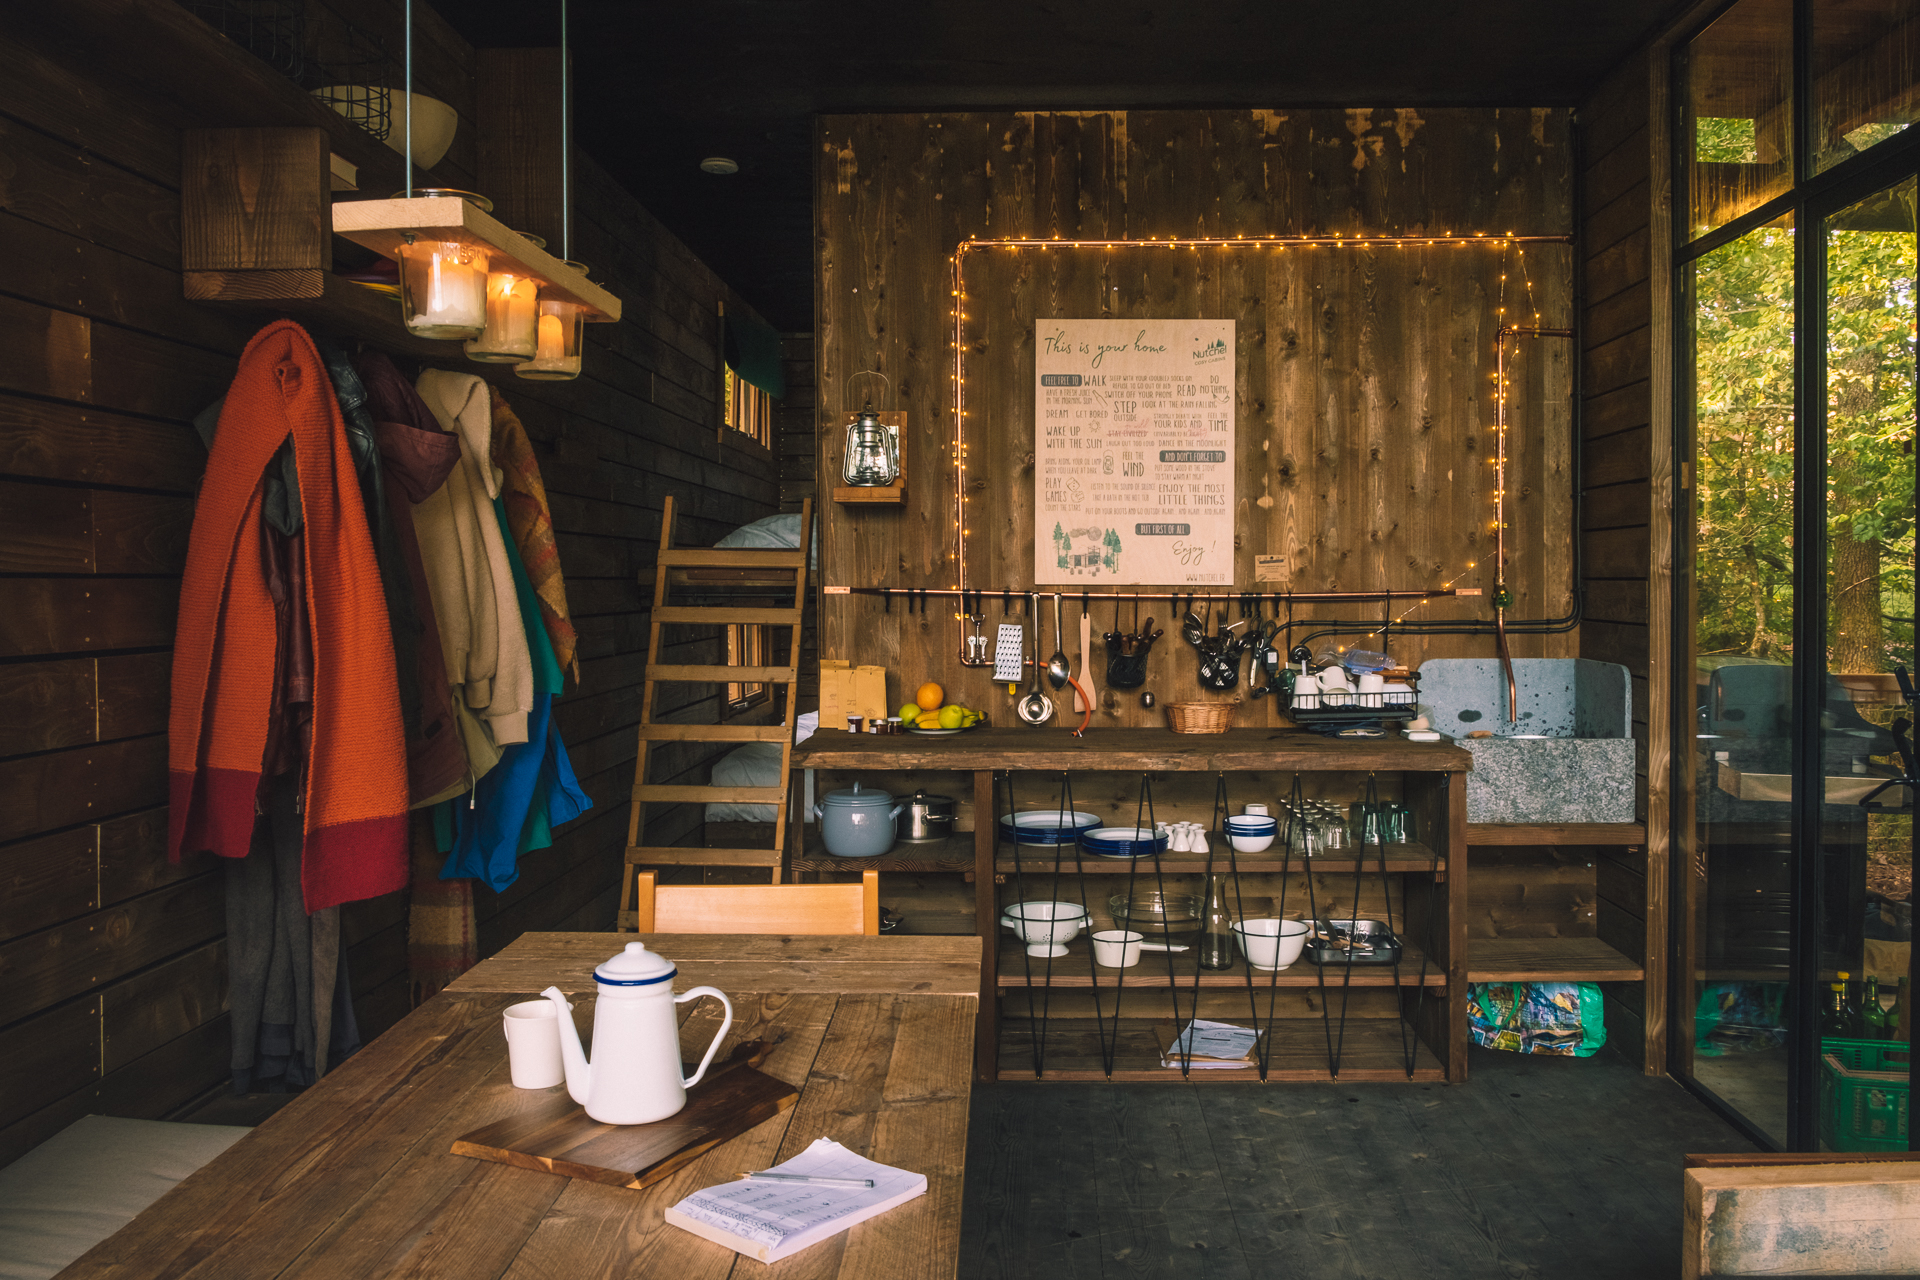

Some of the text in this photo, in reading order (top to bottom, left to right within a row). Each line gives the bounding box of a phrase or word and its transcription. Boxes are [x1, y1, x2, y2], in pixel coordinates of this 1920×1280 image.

[1044, 329, 1168, 369] This is your home
[1192, 344, 1227, 359] Nutchel
[1045, 375, 1107, 387] FEEL FREE TO WALK
[1210, 375, 1219, 384] DO
[1104, 390, 1172, 399] SWITCH OFF YOUR PHONE
[1176, 384, 1197, 397] READ
[1052, 397, 1060, 405] THE
[1113, 400, 1137, 413] STEP
[1142, 400, 1217, 409] LOOK AT THE RAIN FALLING
[1046, 409, 1069, 419] DREAM
[1075, 410, 1109, 419] GET BORED
[1113, 414, 1137, 422] OUTSIDE
[1153, 419, 1203, 428] YOUR KIDS AND
[1208, 420, 1228, 432] TIME
[1045, 426, 1081, 437] WAKE UP
[1045, 438, 1102, 449] WITH THE SUN
[1122, 451, 1144, 460] FEEL THE
[1164, 452, 1223, 462] AND DON'T FORGET TO
[1122, 462, 1145, 477] WIND
[1045, 477, 1062, 489] PLAY
[1158, 483, 1225, 493] ENJOY THE MOST
[1045, 491, 1067, 502] GAMES
[1158, 494, 1225, 505] LITTLE THINGS
[1068, 504, 1081, 512] STARS
[1140, 524, 1185, 535] BUT FIRST OF ALL
[1171, 539, 1206, 567] Enjoy
